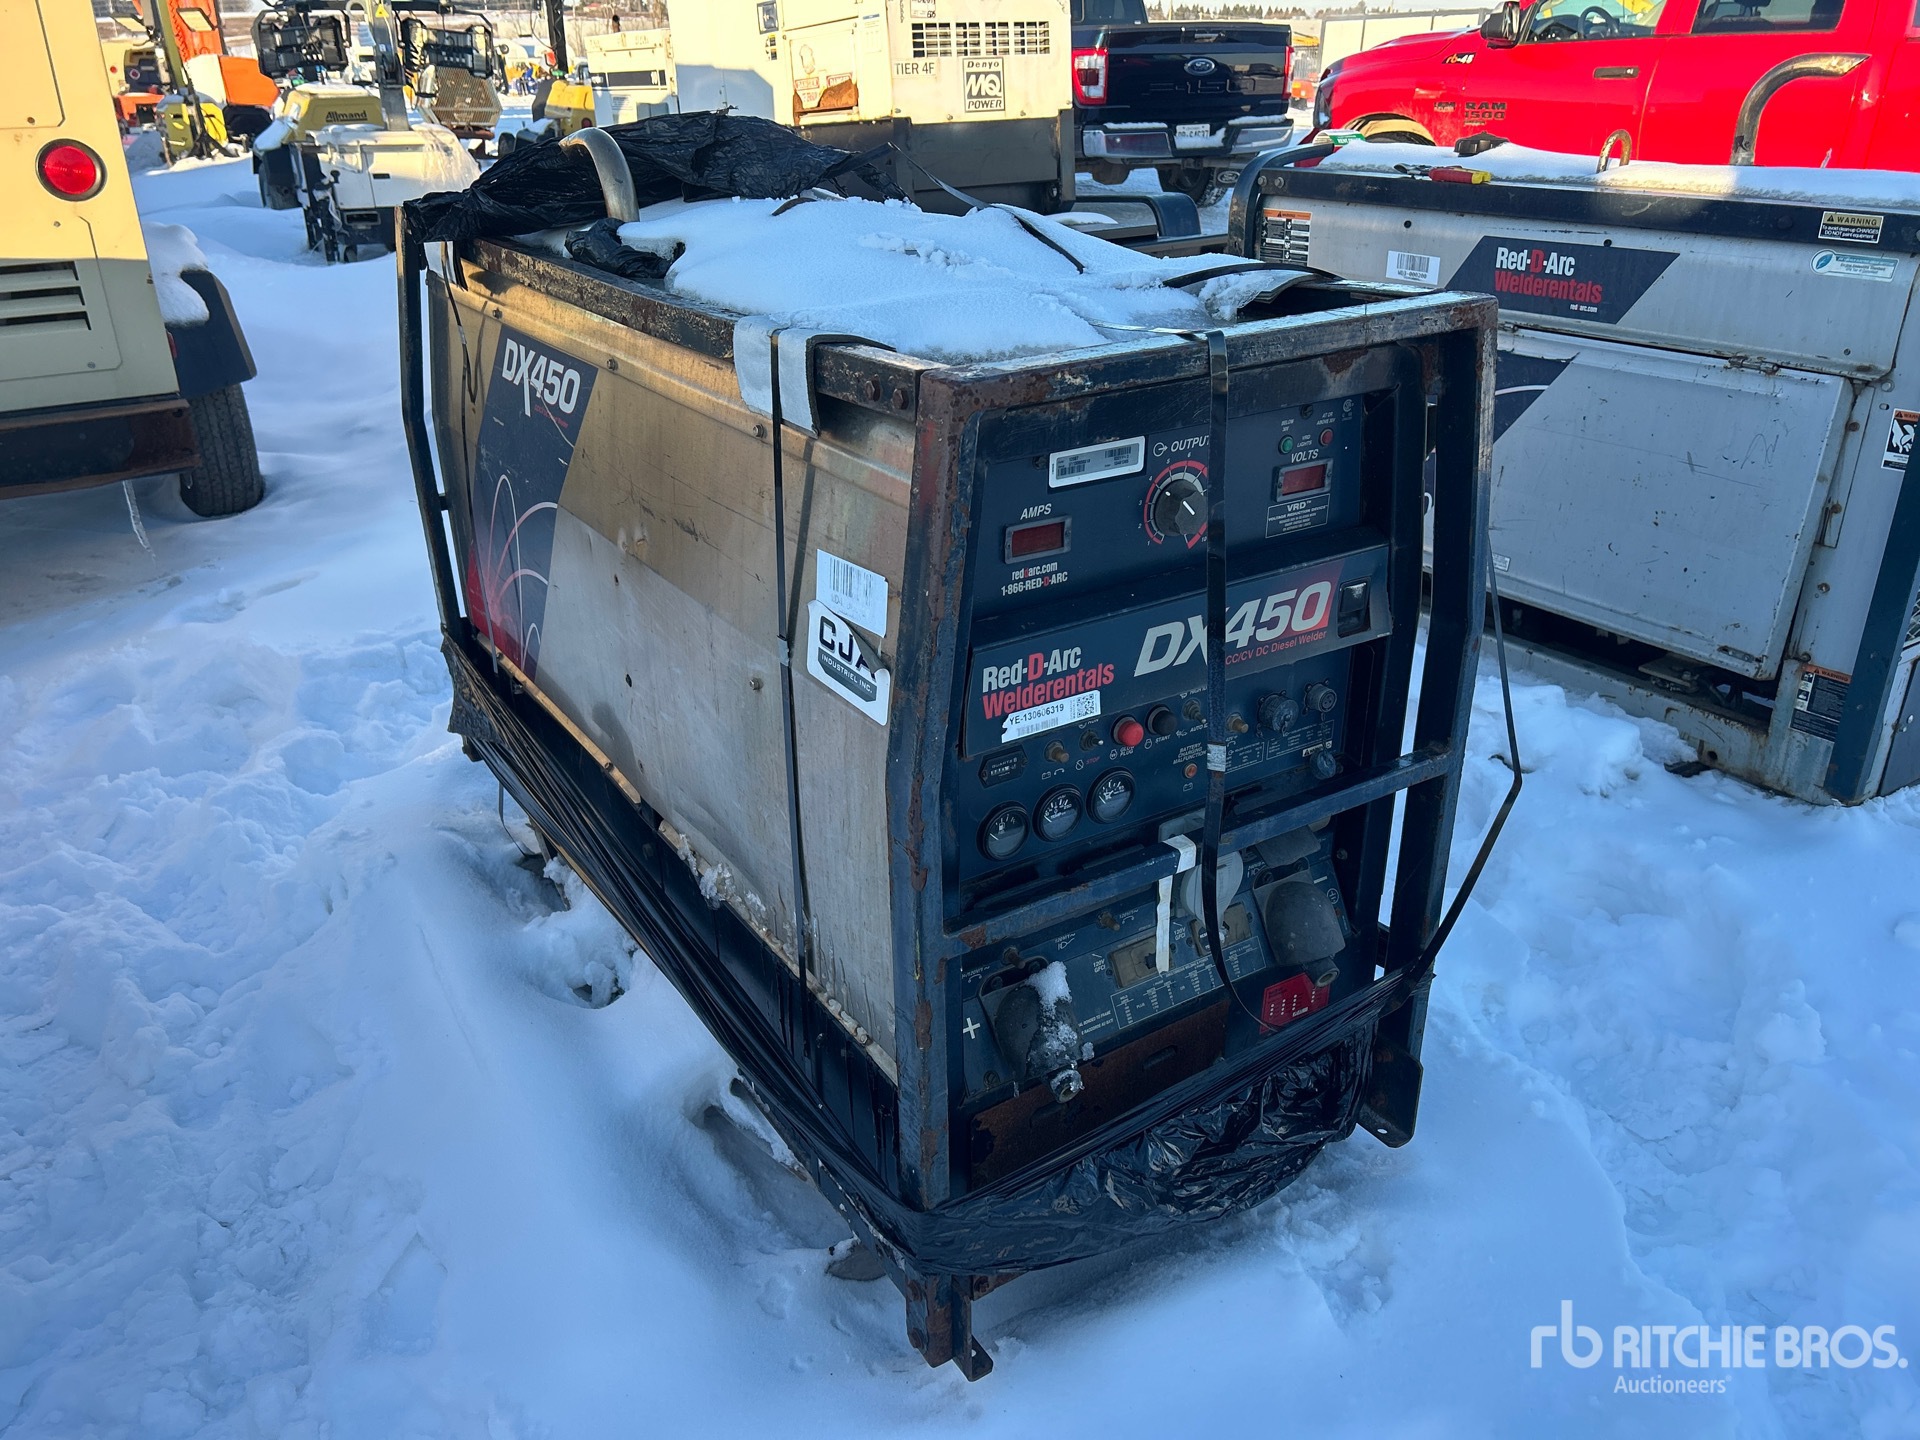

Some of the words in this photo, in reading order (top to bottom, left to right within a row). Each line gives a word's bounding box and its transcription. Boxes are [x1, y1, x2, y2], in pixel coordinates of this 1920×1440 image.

[894, 63, 919, 75] TIER
[922, 62, 935, 74] 4F
[967, 60, 1000, 69] Denyo
[966, 73, 1002, 98] MQ
[967, 99, 1002, 109] POWER
[326, 110, 368, 122] Allmand
[1837, 216, 1878, 226] WARNING
[1495, 270, 1603, 304] Welderentals
[502, 338, 580, 417] DX450
[1291, 448, 1319, 463] VOLTS
[1020, 503, 1052, 520] AMPS
[1011, 561, 1058, 581] reddarc.com
[1001, 571, 1068, 596] 1-866-RED-D-ARC
[1256, 645, 1269, 657] DC
[1271, 636, 1297, 653] Diesel
[1298, 631, 1327, 645] Welder
[821, 653, 858, 684] INDUSTRIEL
[858, 679, 873, 694] INC.
[1821, 670, 1849, 682] WARNING
[982, 663, 1115, 720] Welderentals
[1009, 704, 1065, 725] YE-130606319
[1190, 724, 1203, 732] AUTO
[1155, 734, 1171, 744] START
[1120, 748, 1133, 757] PLUG
[1177, 746, 1203, 758] CHARGING
[1179, 742, 1202, 753] BATTERY
[1173, 750, 1207, 765] MALFUNCTION
[1173, 926, 1186, 935] 120V
[1174, 932, 1186, 941] GFCI
[1093, 958, 1105, 968] 120V
[1094, 964, 1106, 973] GFCI
